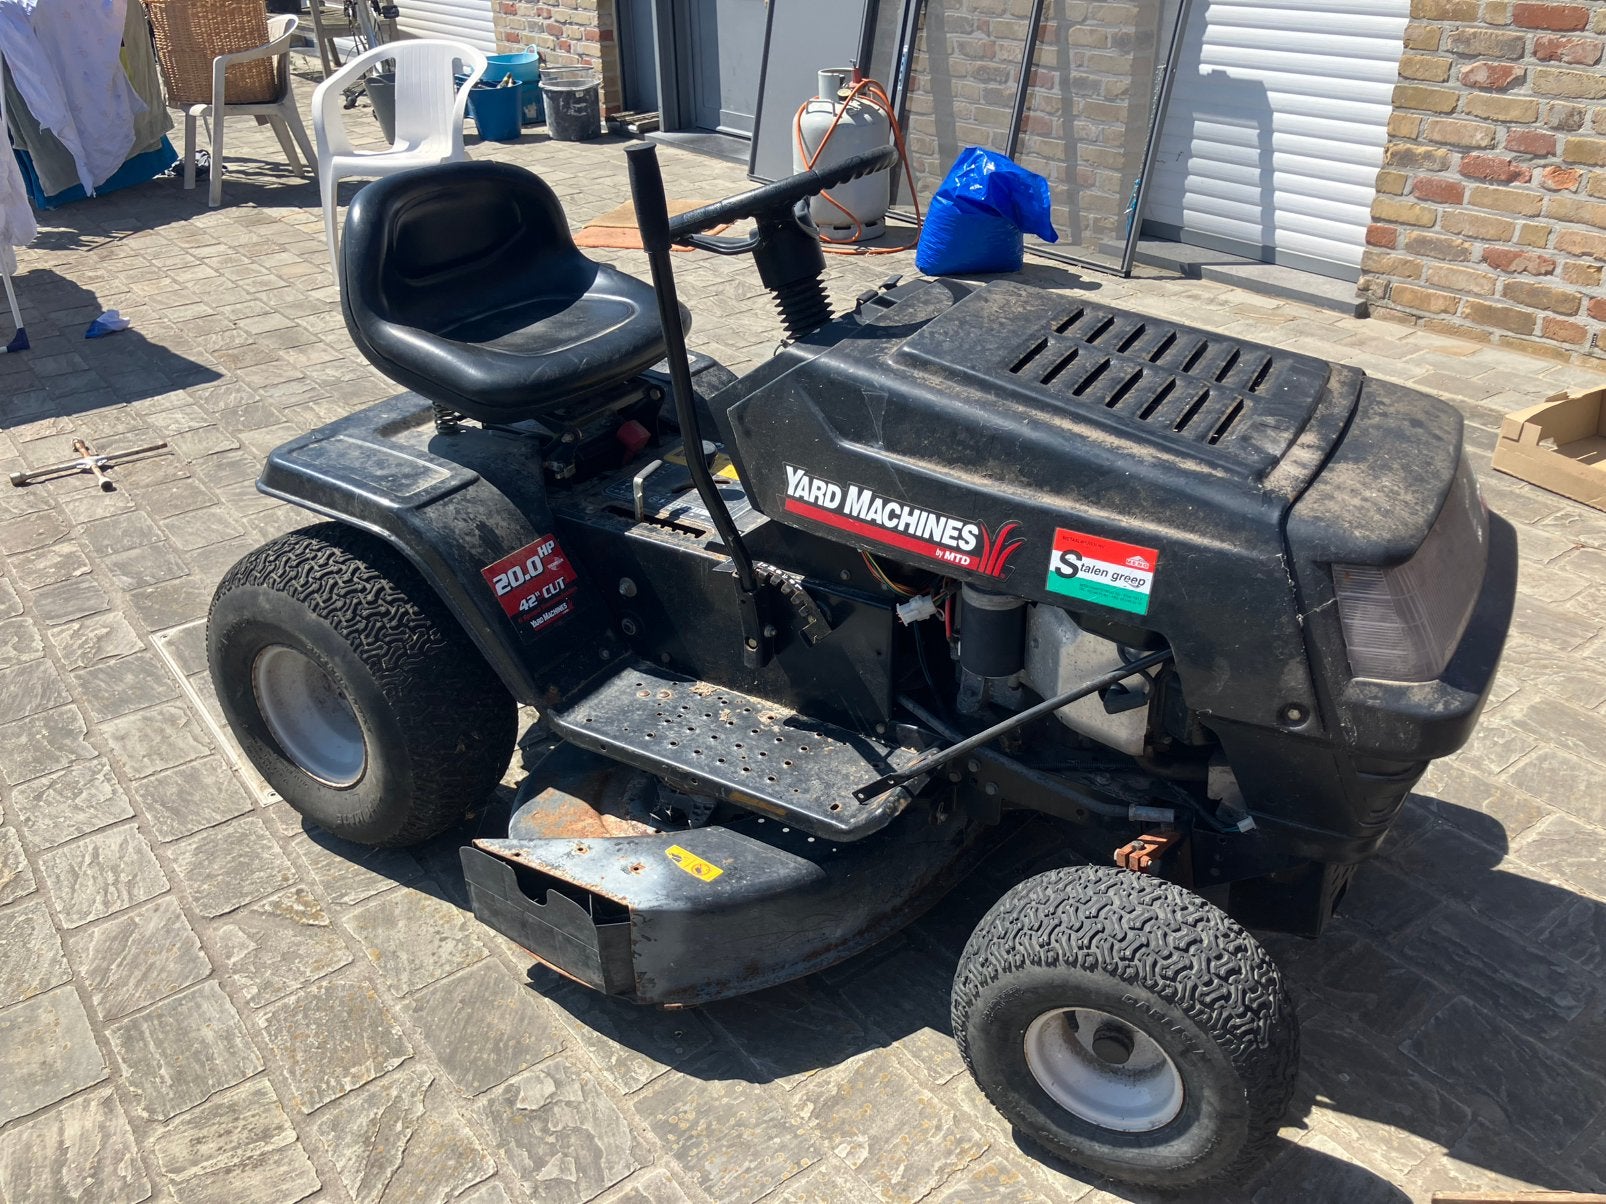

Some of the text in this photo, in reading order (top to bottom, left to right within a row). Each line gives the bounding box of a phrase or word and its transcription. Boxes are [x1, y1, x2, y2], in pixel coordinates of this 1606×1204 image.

[786, 465, 979, 551] YARD MACHINES
[493, 555, 544, 596] 20.0
[537, 540, 555, 558] HP
[935, 548, 970, 565] by MTD
[1054, 549, 1146, 588] Stalen greep
[543, 577, 566, 598] CUT
[543, 602, 568, 621] MACHINES
